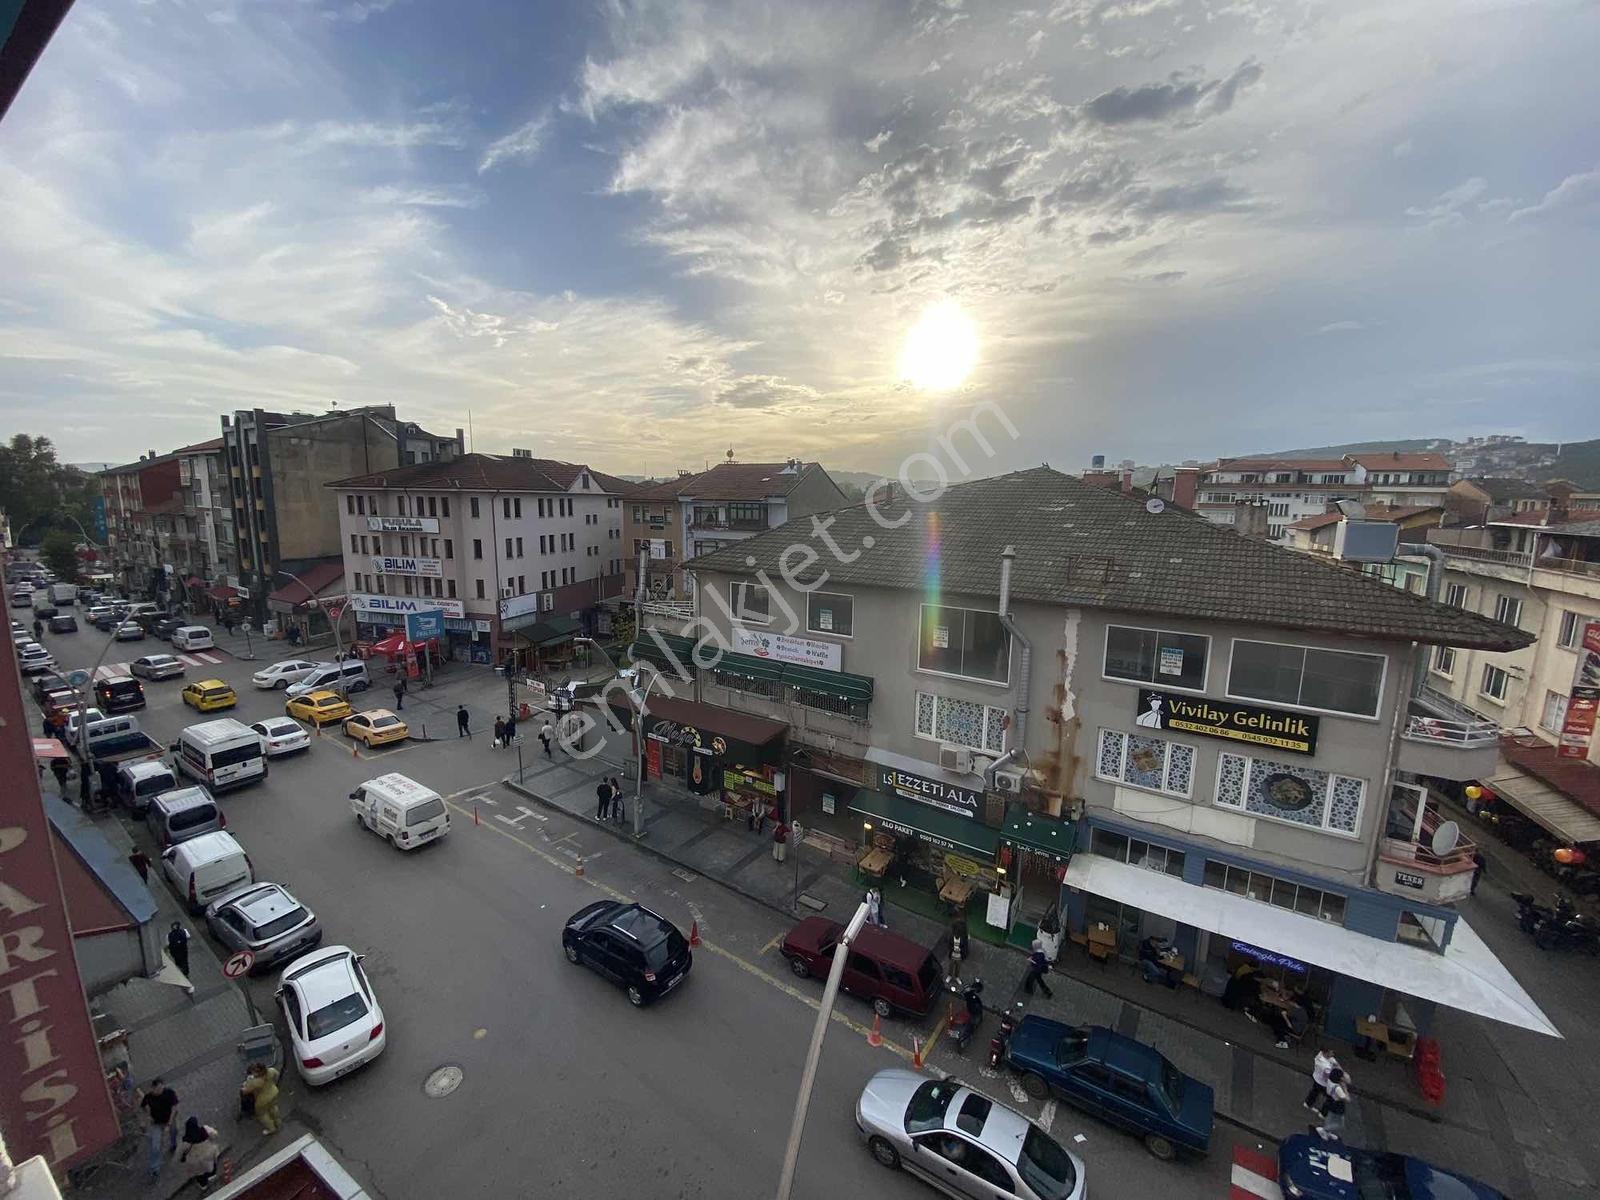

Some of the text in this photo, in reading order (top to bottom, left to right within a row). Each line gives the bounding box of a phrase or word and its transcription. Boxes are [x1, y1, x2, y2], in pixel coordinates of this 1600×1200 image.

[1168, 699, 1310, 736] Vivilay Gelinlik
[1174, 721, 1192, 730] 0532
[1194, 725, 1208, 733] 402
[881, 820, 894, 829] ALO
[894, 824, 914, 836] PAKET
